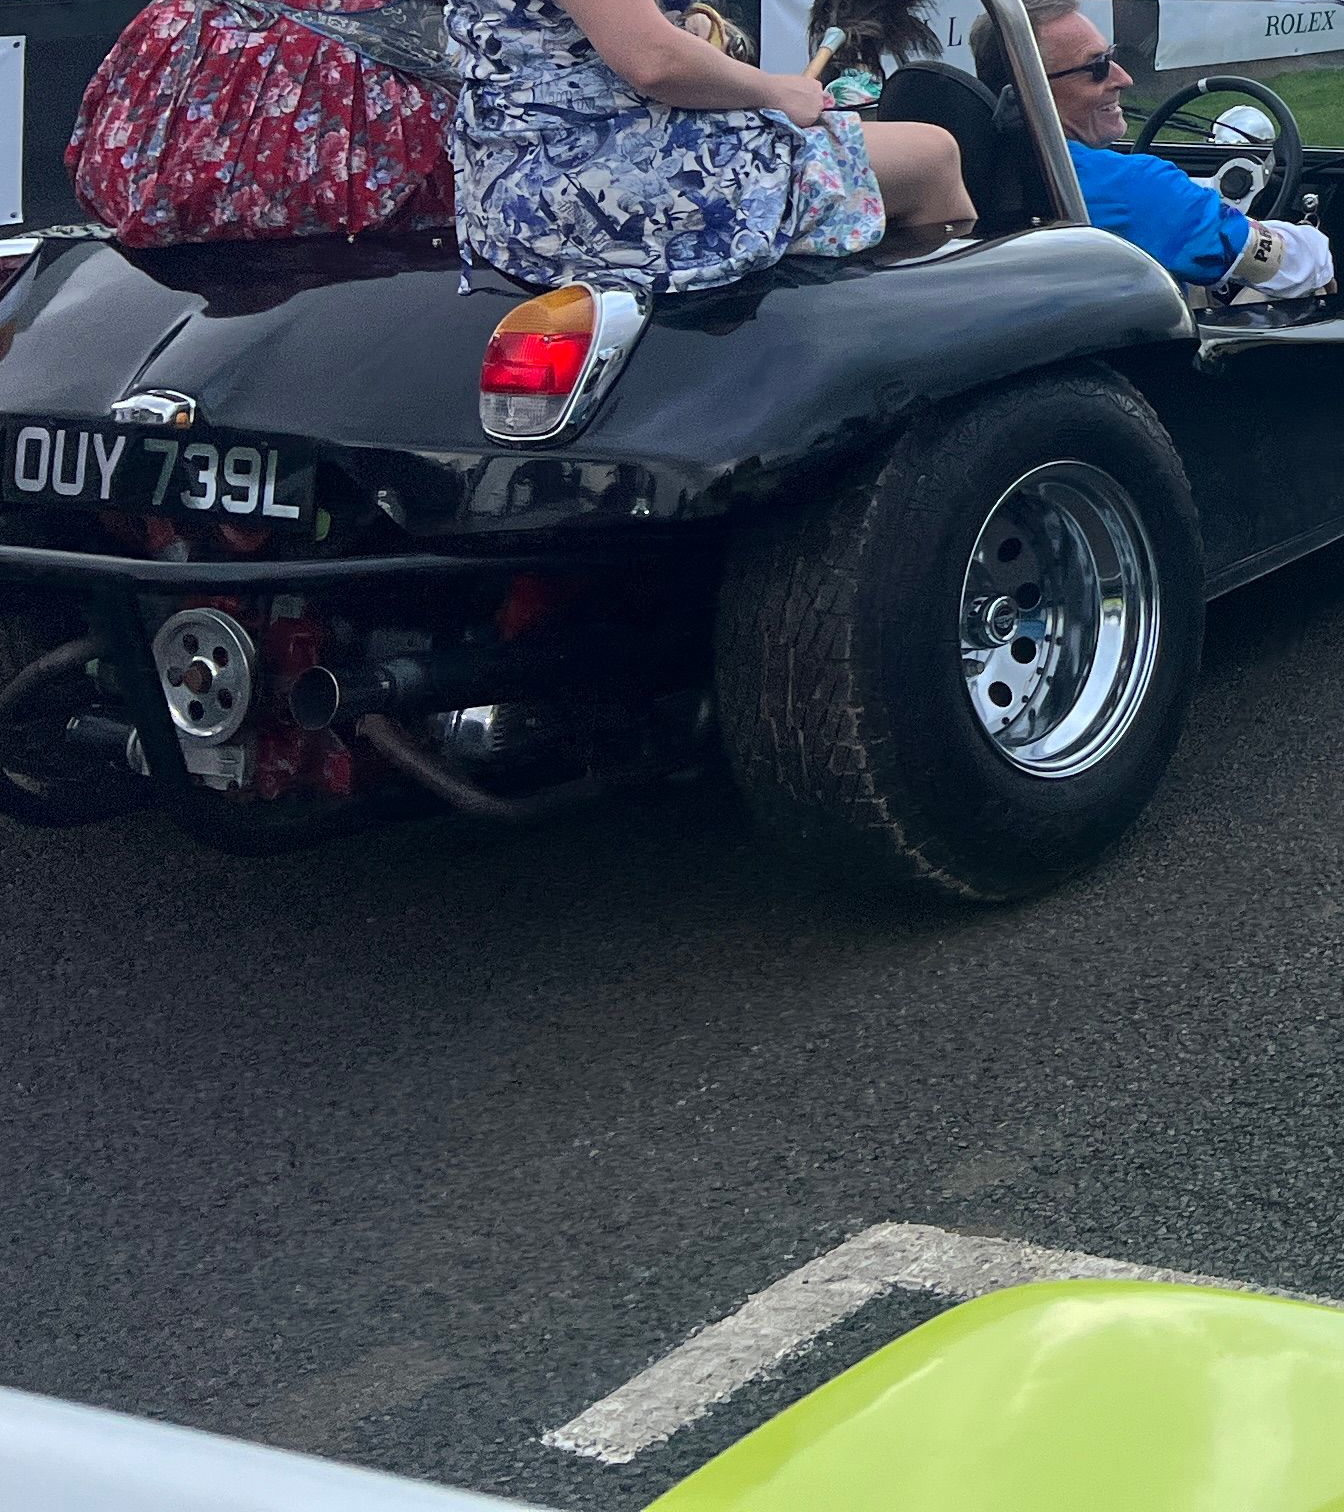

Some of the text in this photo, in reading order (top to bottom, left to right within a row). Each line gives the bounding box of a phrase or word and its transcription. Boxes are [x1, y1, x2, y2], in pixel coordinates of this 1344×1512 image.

[1265, 10, 1336, 36] ROLEX
[15, 427, 300, 519] OUY 739L
